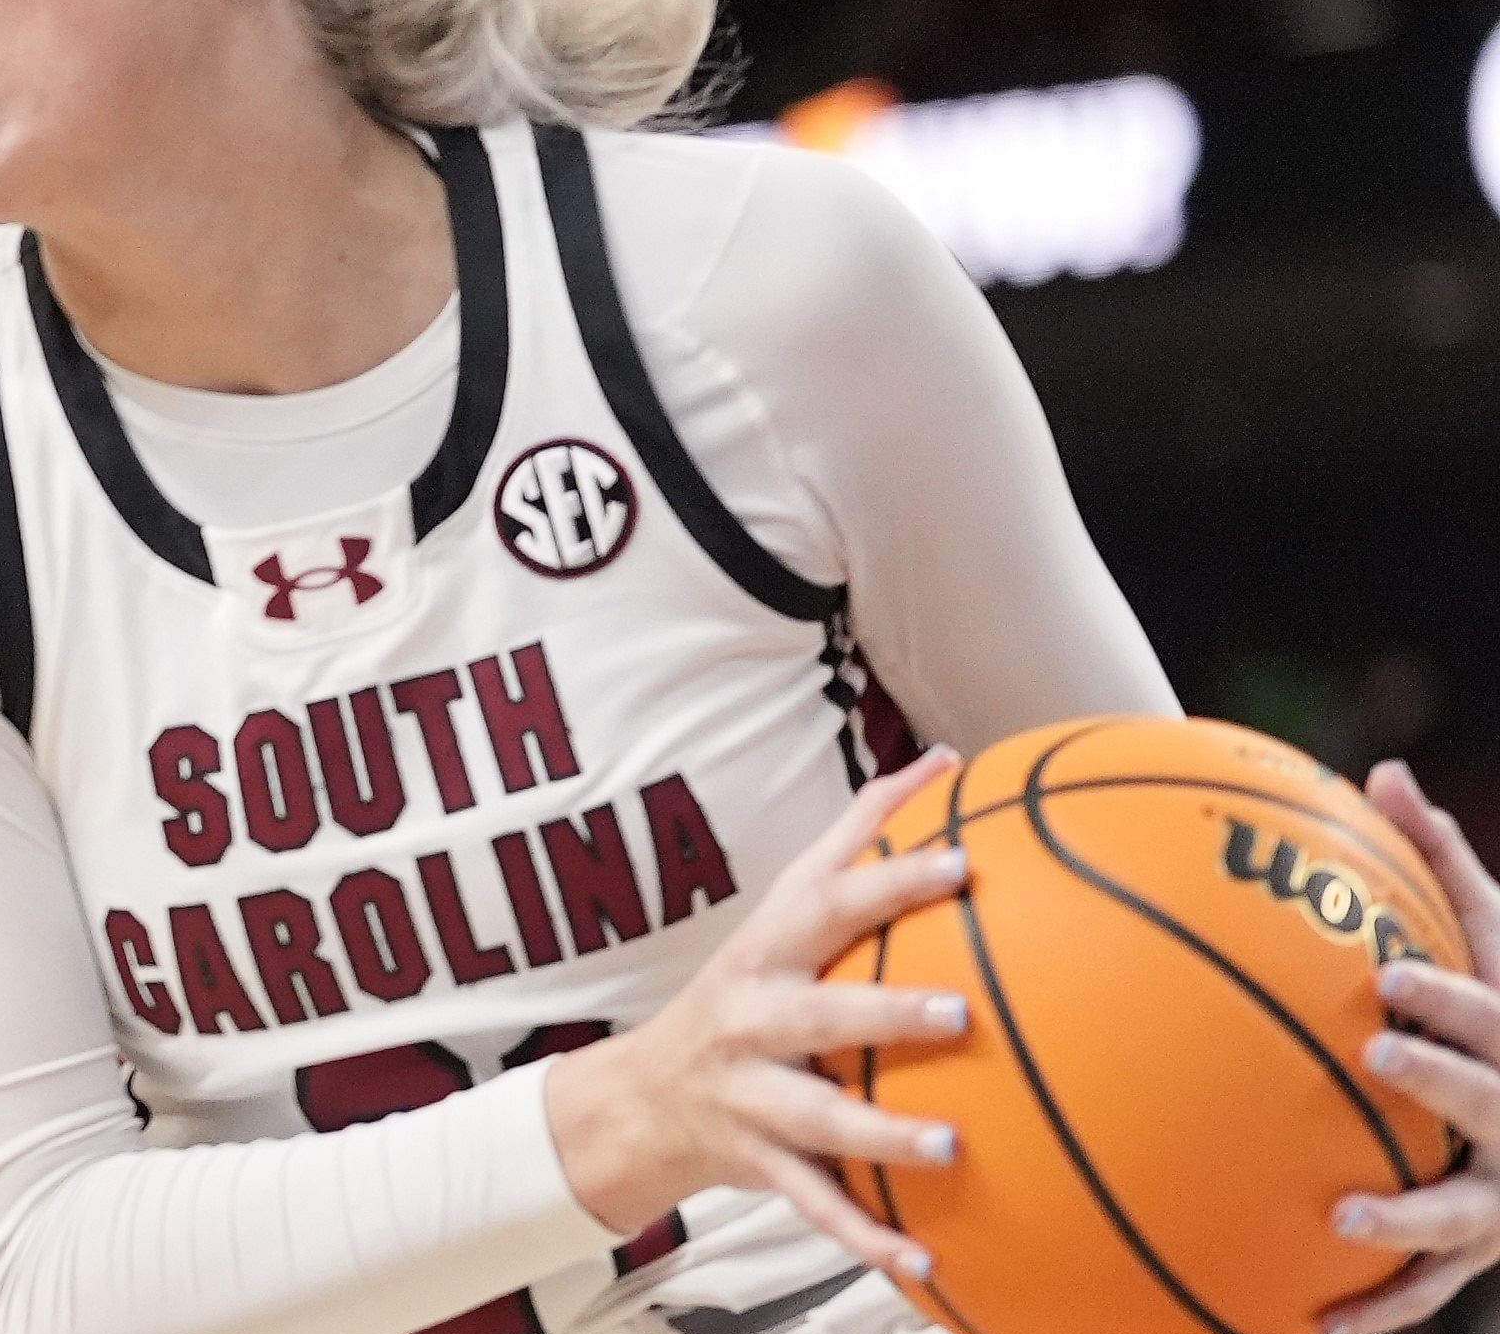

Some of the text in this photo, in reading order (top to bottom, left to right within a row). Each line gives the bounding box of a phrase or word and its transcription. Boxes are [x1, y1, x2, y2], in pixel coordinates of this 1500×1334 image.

[501, 444, 629, 570] SEC
[148, 639, 581, 867] SOUTH
[105, 772, 739, 1036] CAROLINA
